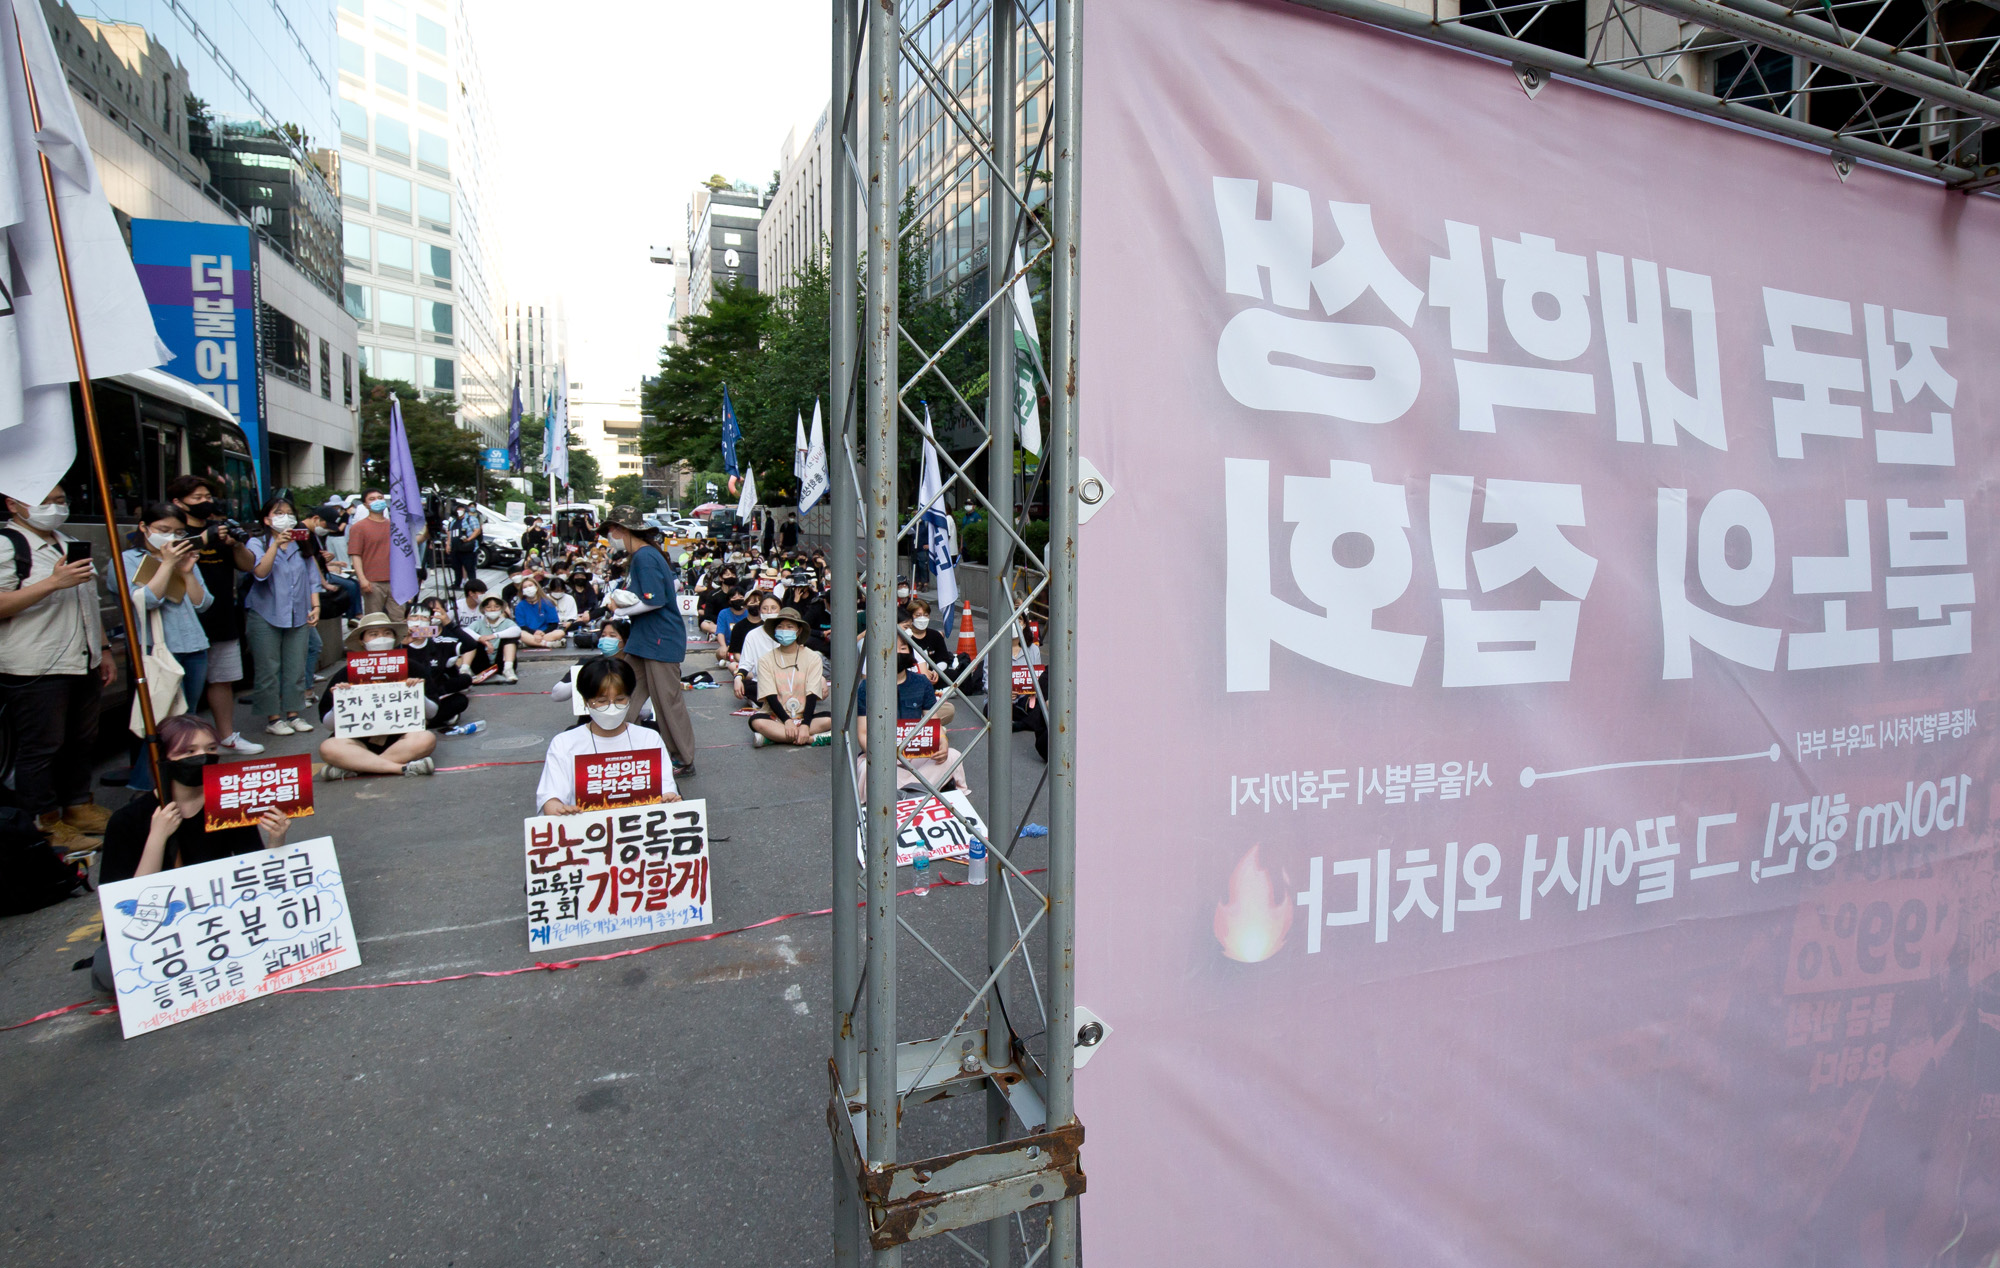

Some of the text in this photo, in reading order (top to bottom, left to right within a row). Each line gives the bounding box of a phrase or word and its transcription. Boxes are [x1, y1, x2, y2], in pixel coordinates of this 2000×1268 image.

[339, 711, 376, 733] 구성
[219, 767, 299, 791] 학생의견
[586, 760, 651, 779] 학생의견
[219, 784, 300, 809] 즉각수용!
[586, 775, 651, 795] 즉각수용!
[528, 869, 585, 897] 교육부
[151, 894, 322, 978] 공중분해
[153, 961, 246, 1009] 등록금을
